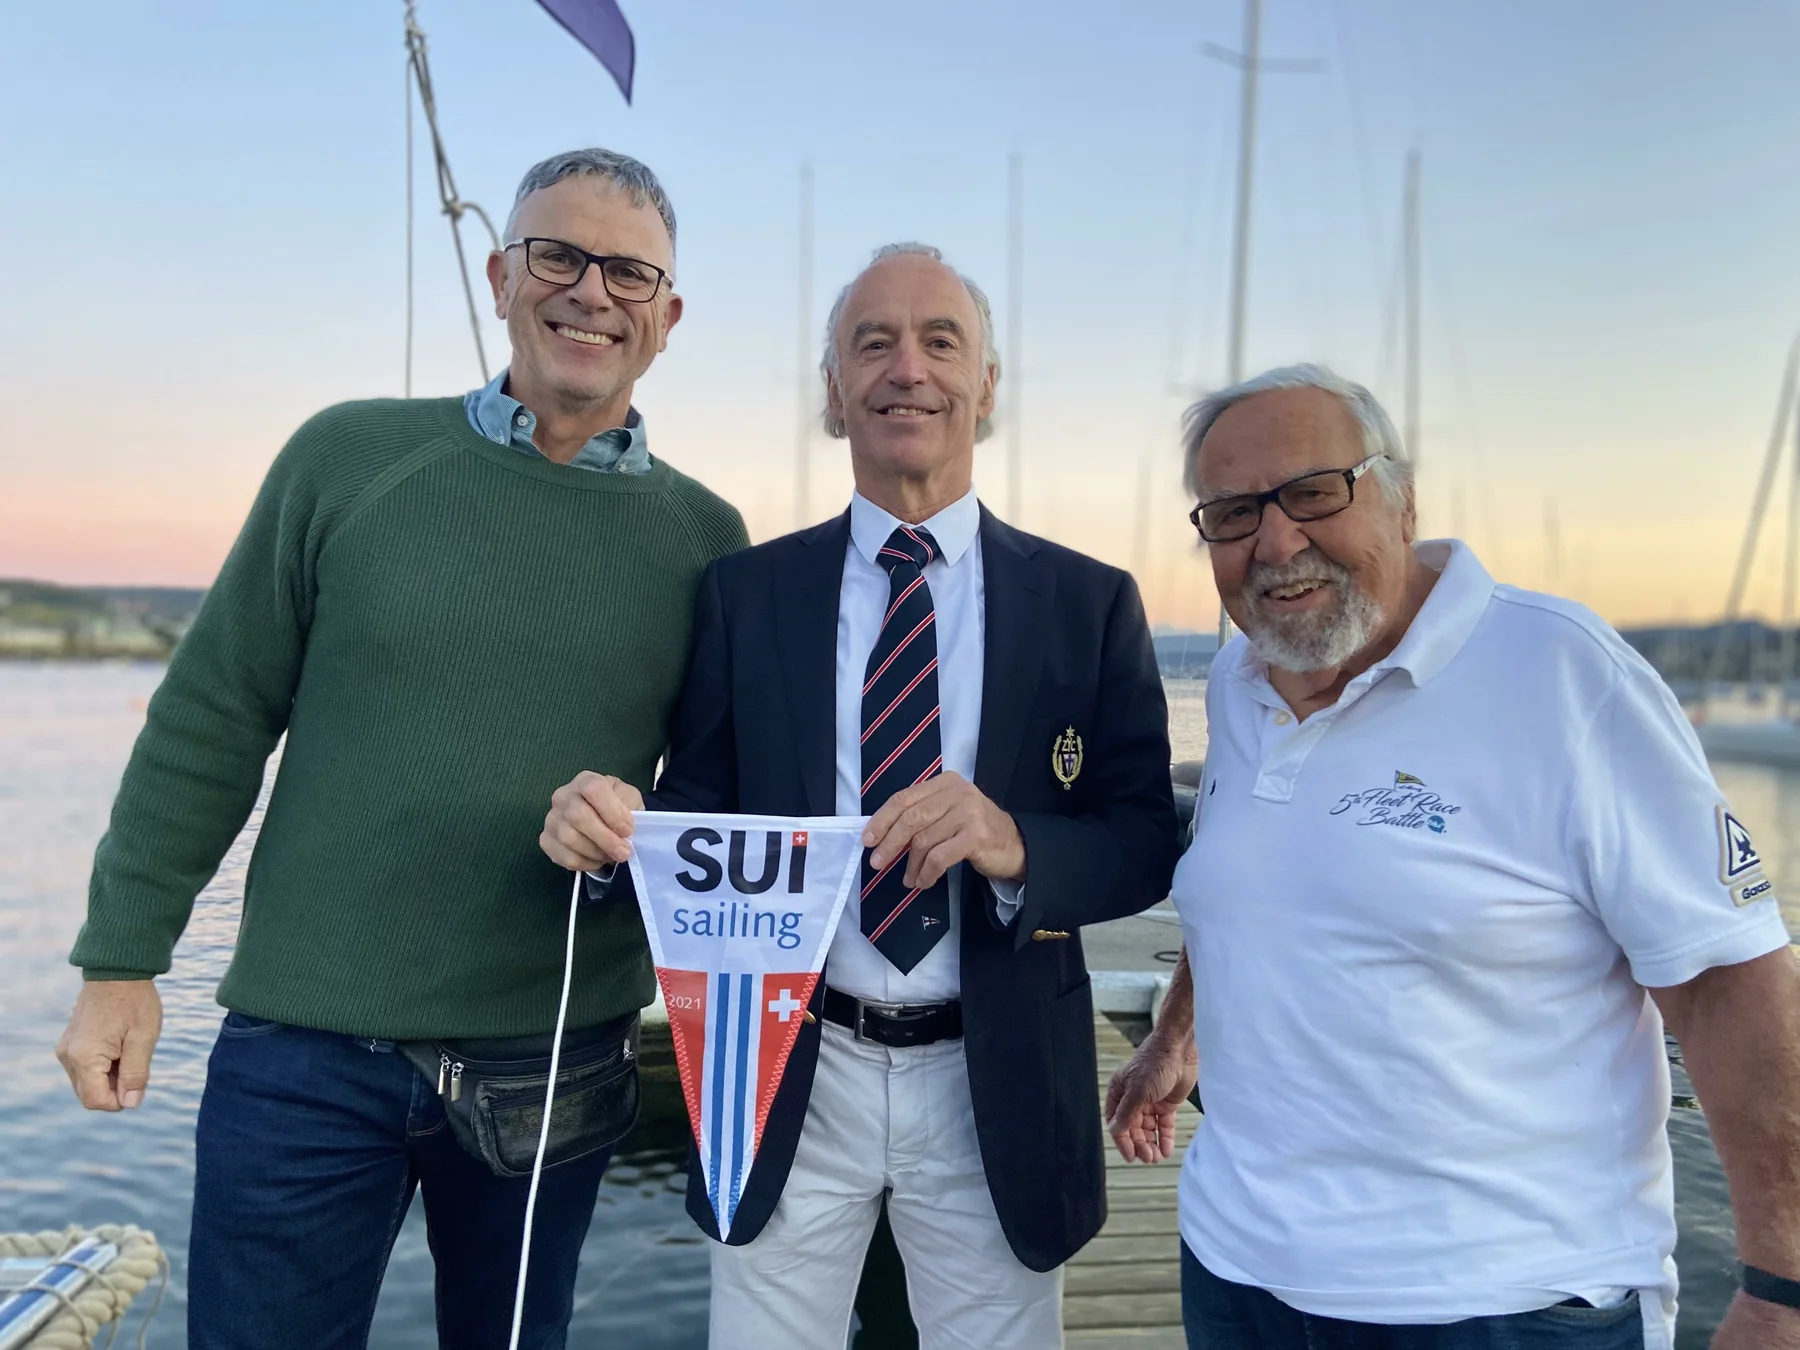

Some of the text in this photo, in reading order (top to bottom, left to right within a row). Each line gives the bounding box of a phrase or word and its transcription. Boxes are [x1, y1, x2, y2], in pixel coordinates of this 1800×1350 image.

[1362, 788, 1413, 808] Fleet
[1411, 792, 1461, 815] Race
[1356, 807, 1425, 829] Battle
[673, 901, 803, 949] sailing
[667, 993, 701, 1010] 2021
